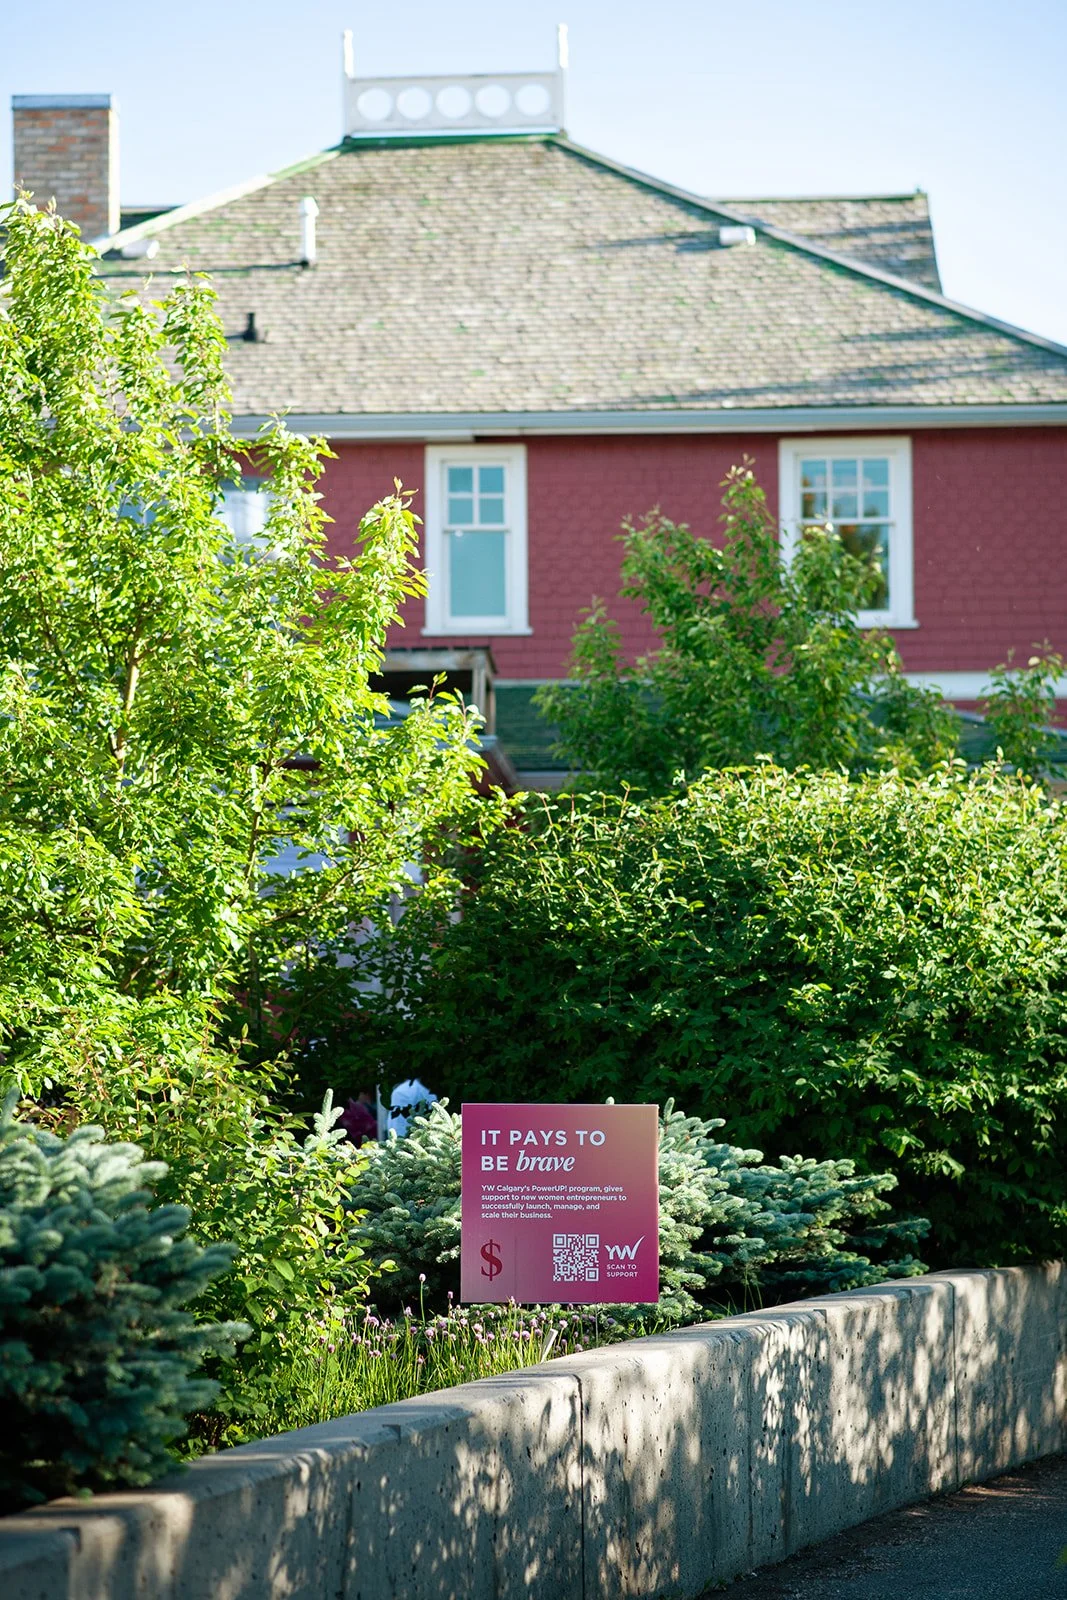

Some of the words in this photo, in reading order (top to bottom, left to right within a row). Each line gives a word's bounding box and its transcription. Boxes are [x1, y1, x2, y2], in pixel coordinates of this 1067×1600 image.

[481, 1130, 500, 1145] IT
[510, 1130, 567, 1145] PAYS
[576, 1130, 605, 1146] TO
[481, 1156, 508, 1171] BE
[516, 1150, 575, 1172] brave
[497, 1185, 530, 1193] Calgary's
[482, 1203, 524, 1211] successfully
